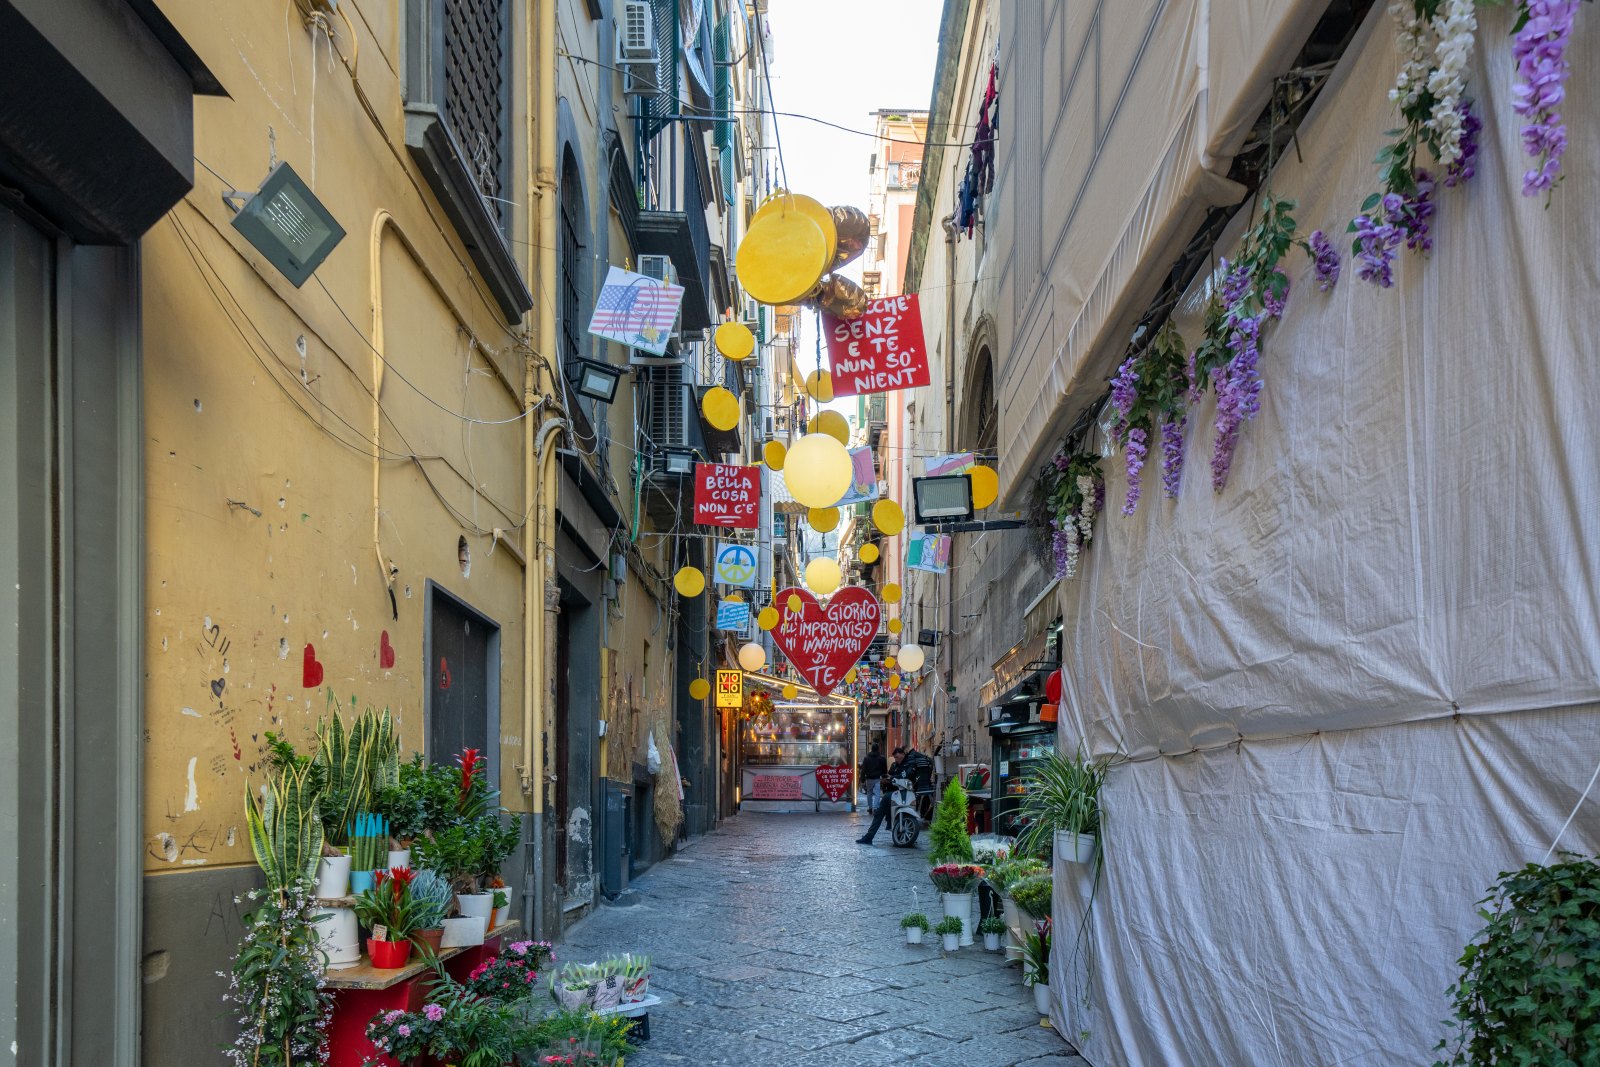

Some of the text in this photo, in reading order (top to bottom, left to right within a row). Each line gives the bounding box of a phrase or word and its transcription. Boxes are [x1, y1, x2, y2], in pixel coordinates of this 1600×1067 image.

[834, 315, 903, 343] SENZ'
[848, 336, 899, 358] E TE
[835, 356, 875, 377] NUN
[705, 476, 753, 490] BELLA
[711, 490, 749, 502] COSA
[699, 502, 727, 514] NON
[784, 599, 877, 625] UN GIORNO
[785, 634, 864, 654] MI INNAMORAI
[812, 651, 831, 664] DI
